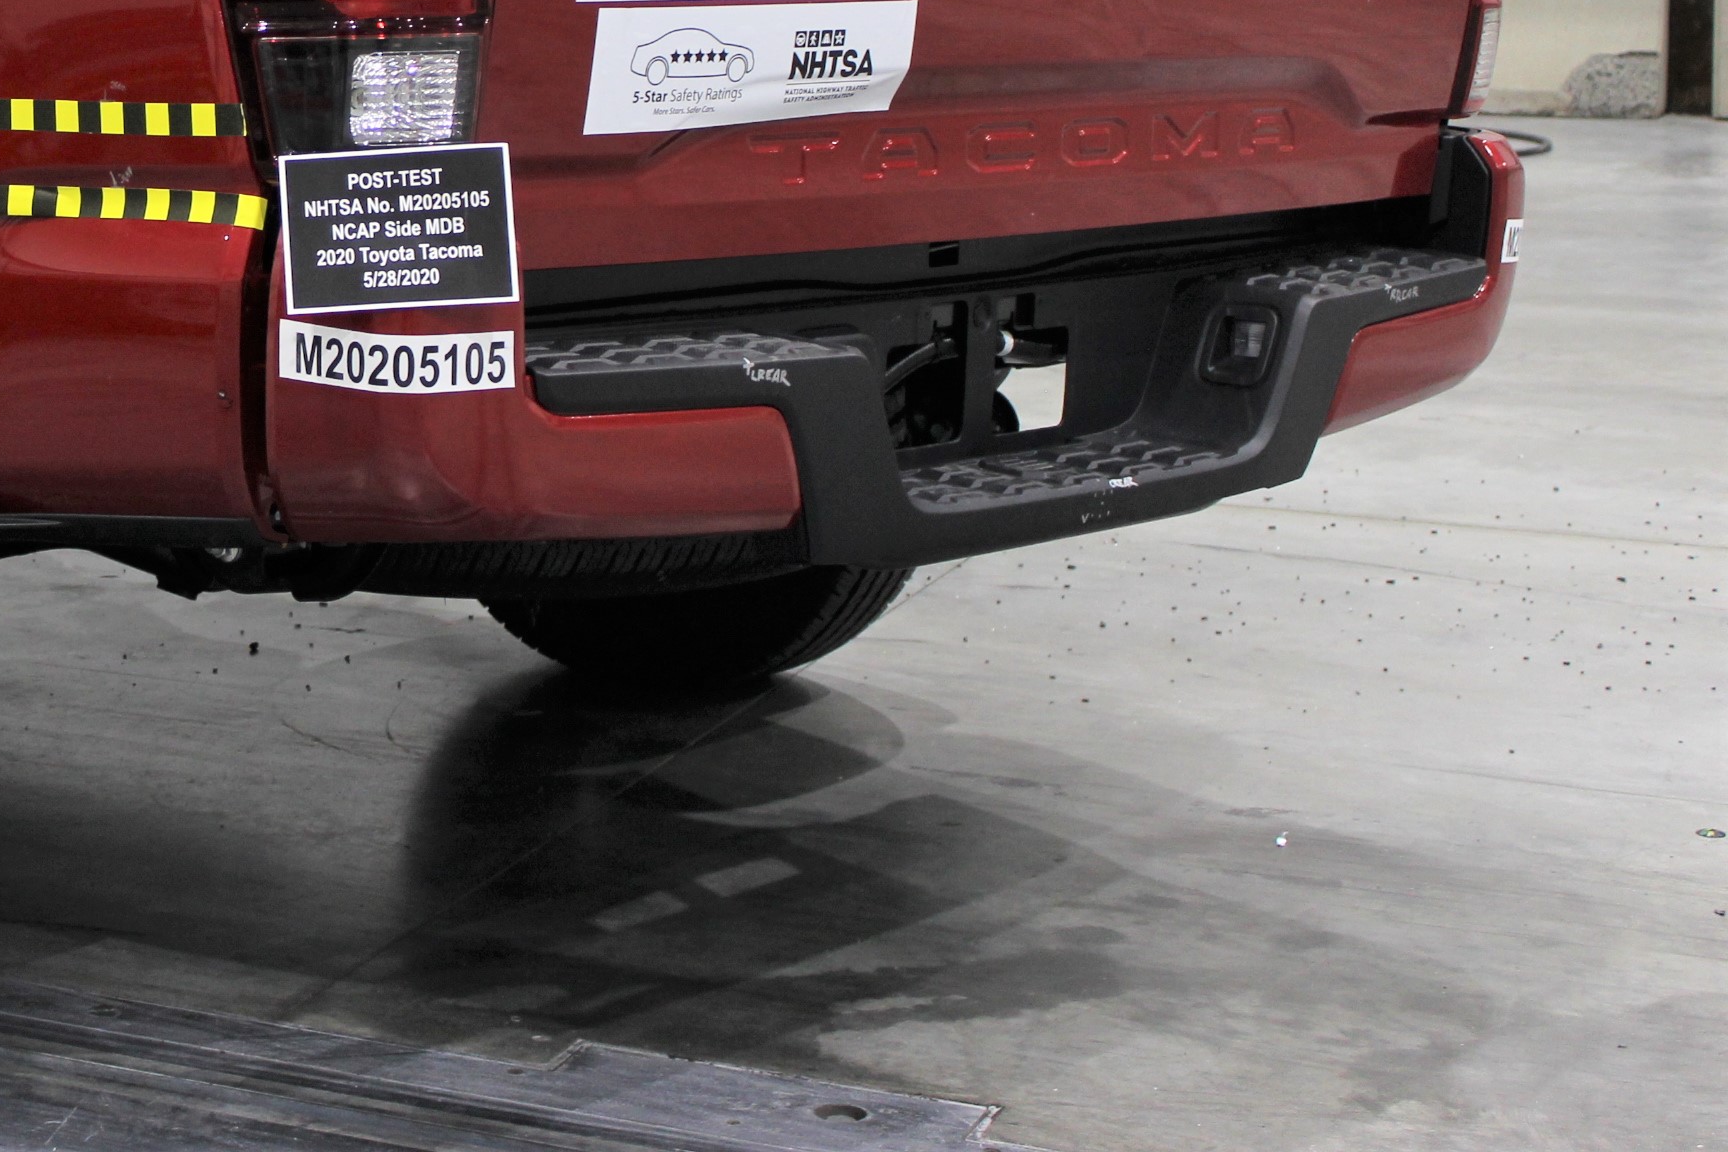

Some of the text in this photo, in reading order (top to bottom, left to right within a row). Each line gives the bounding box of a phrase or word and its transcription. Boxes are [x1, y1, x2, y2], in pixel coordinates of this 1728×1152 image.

[787, 48, 873, 80] NHTSA
[632, 88, 743, 104] 5-Star Safety Ratings
[748, 107, 1295, 184] TACOMA
[347, 168, 443, 190] POST-TEST
[304, 190, 490, 217] NHTSA No. M20205105
[332, 217, 465, 241] NCAP Side MDB
[317, 243, 483, 266] 2020 Toyota Tacoma
[363, 267, 440, 288] 5/28/2020
[295, 332, 506, 388] M20205105
[751, 369, 791, 387] LREAR
